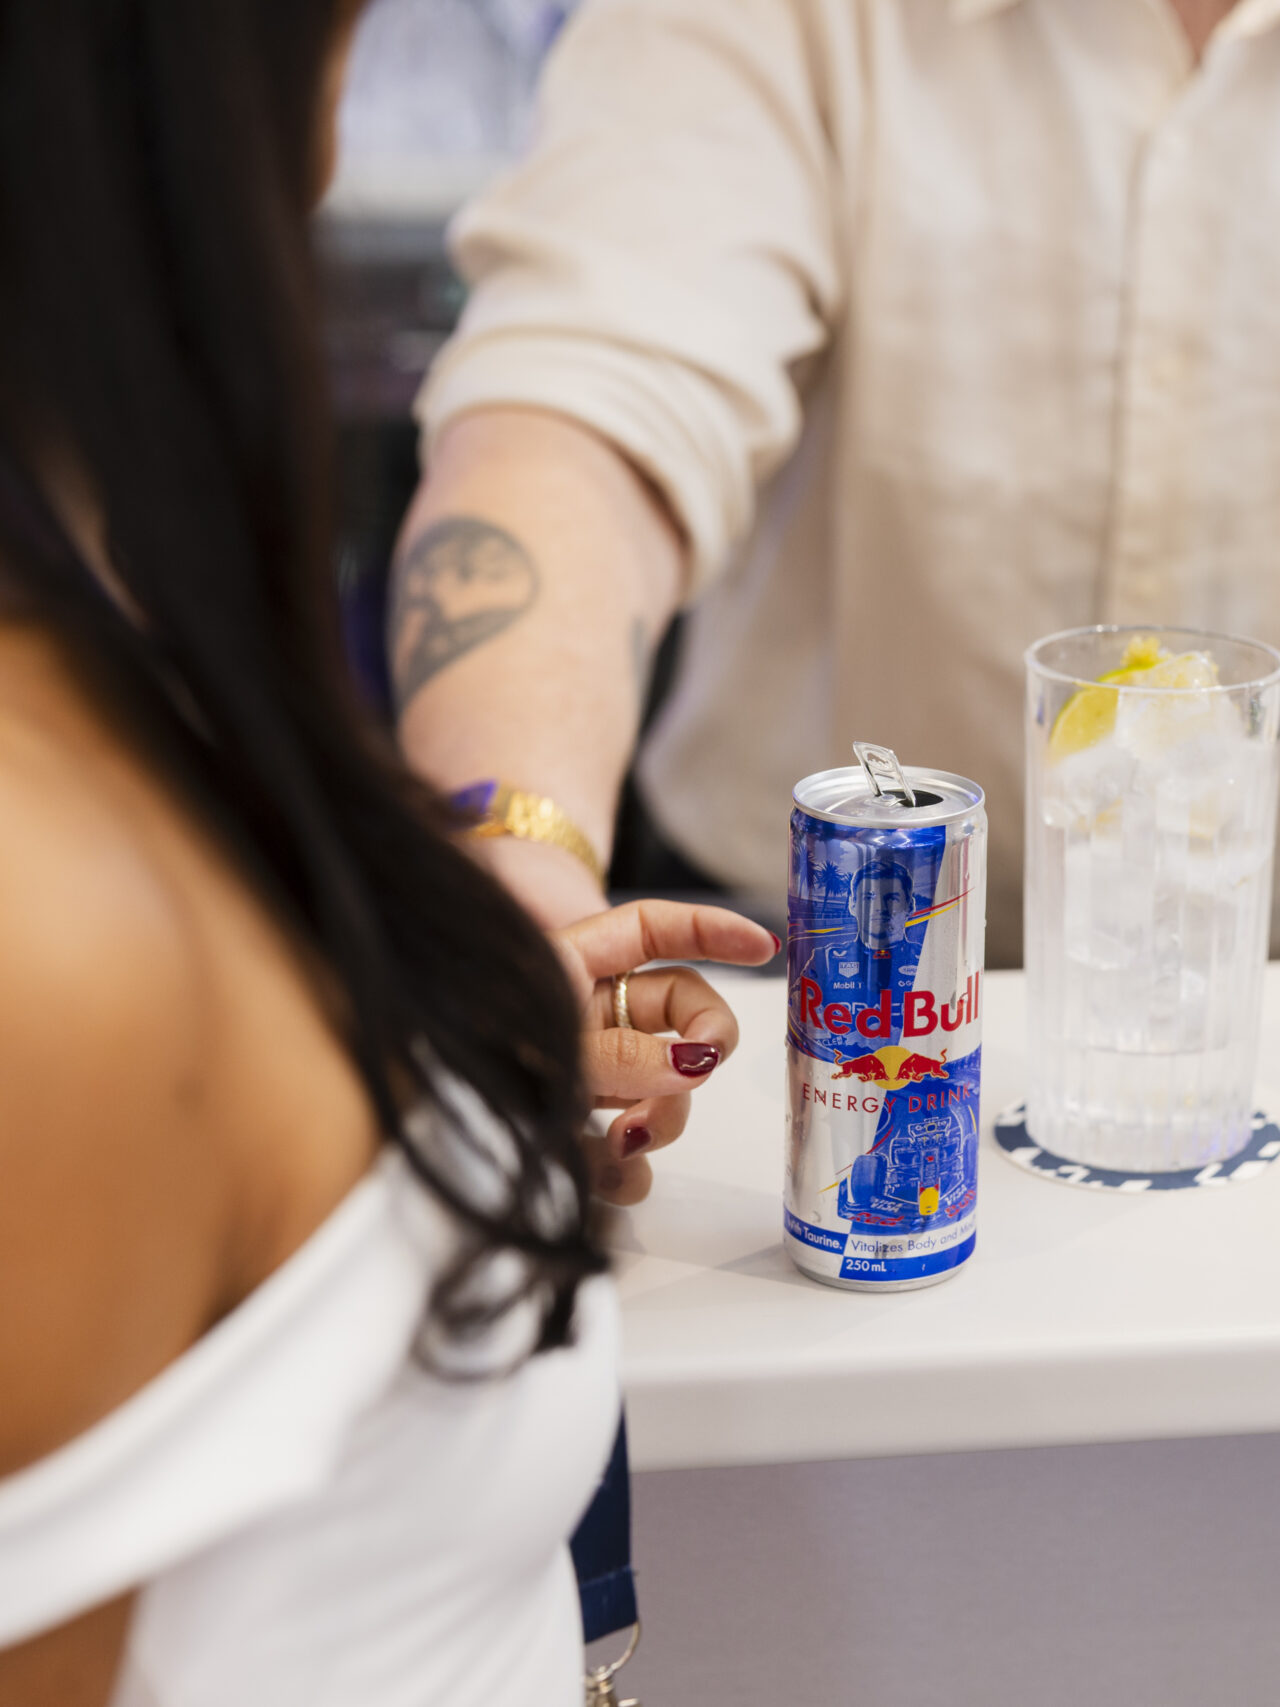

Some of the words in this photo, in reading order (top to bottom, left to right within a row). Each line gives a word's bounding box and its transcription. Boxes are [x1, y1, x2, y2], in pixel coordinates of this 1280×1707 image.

[833, 981, 855, 990] Mobil
[800, 976, 892, 1039] Red
[903, 971, 980, 1038] Bull
[802, 1083, 897, 1114] ENERGY
[908, 1081, 971, 1113] DRINK
[869, 1197, 903, 1213] VISA
[945, 1184, 967, 1206] VISA
[803, 1226, 843, 1250] Taurine.
[851, 1240, 904, 1253] Vitalizes
[907, 1235, 936, 1251] Body
[940, 1227, 958, 1245] and
